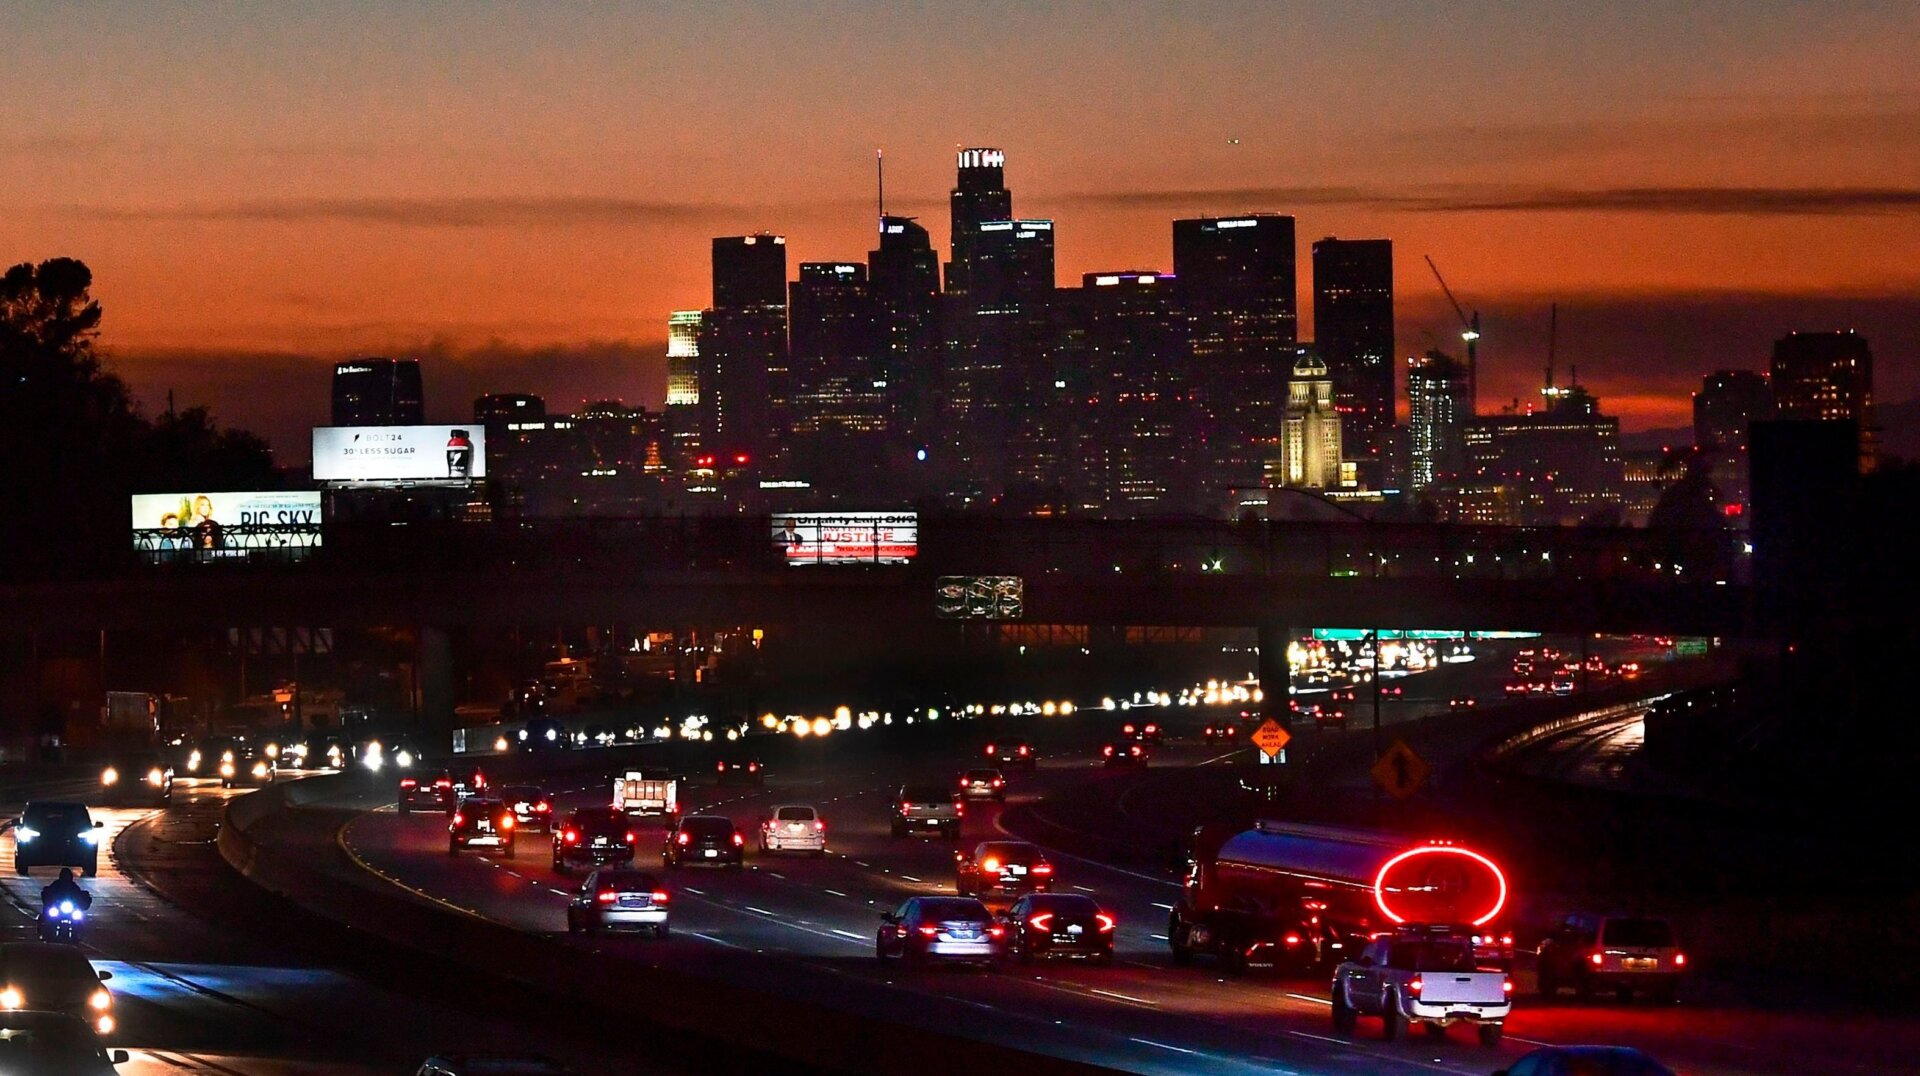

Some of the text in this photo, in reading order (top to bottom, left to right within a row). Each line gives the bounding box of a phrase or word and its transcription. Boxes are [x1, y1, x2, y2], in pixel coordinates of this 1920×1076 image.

[366, 433, 403, 442] BOLT24
[360, 447, 382, 455] LESS
[384, 447, 416, 455] SUGAR
[277, 510, 314, 530] SKY
[797, 515, 850, 525] Unairly
[822, 532, 894, 543] JUSTICE
